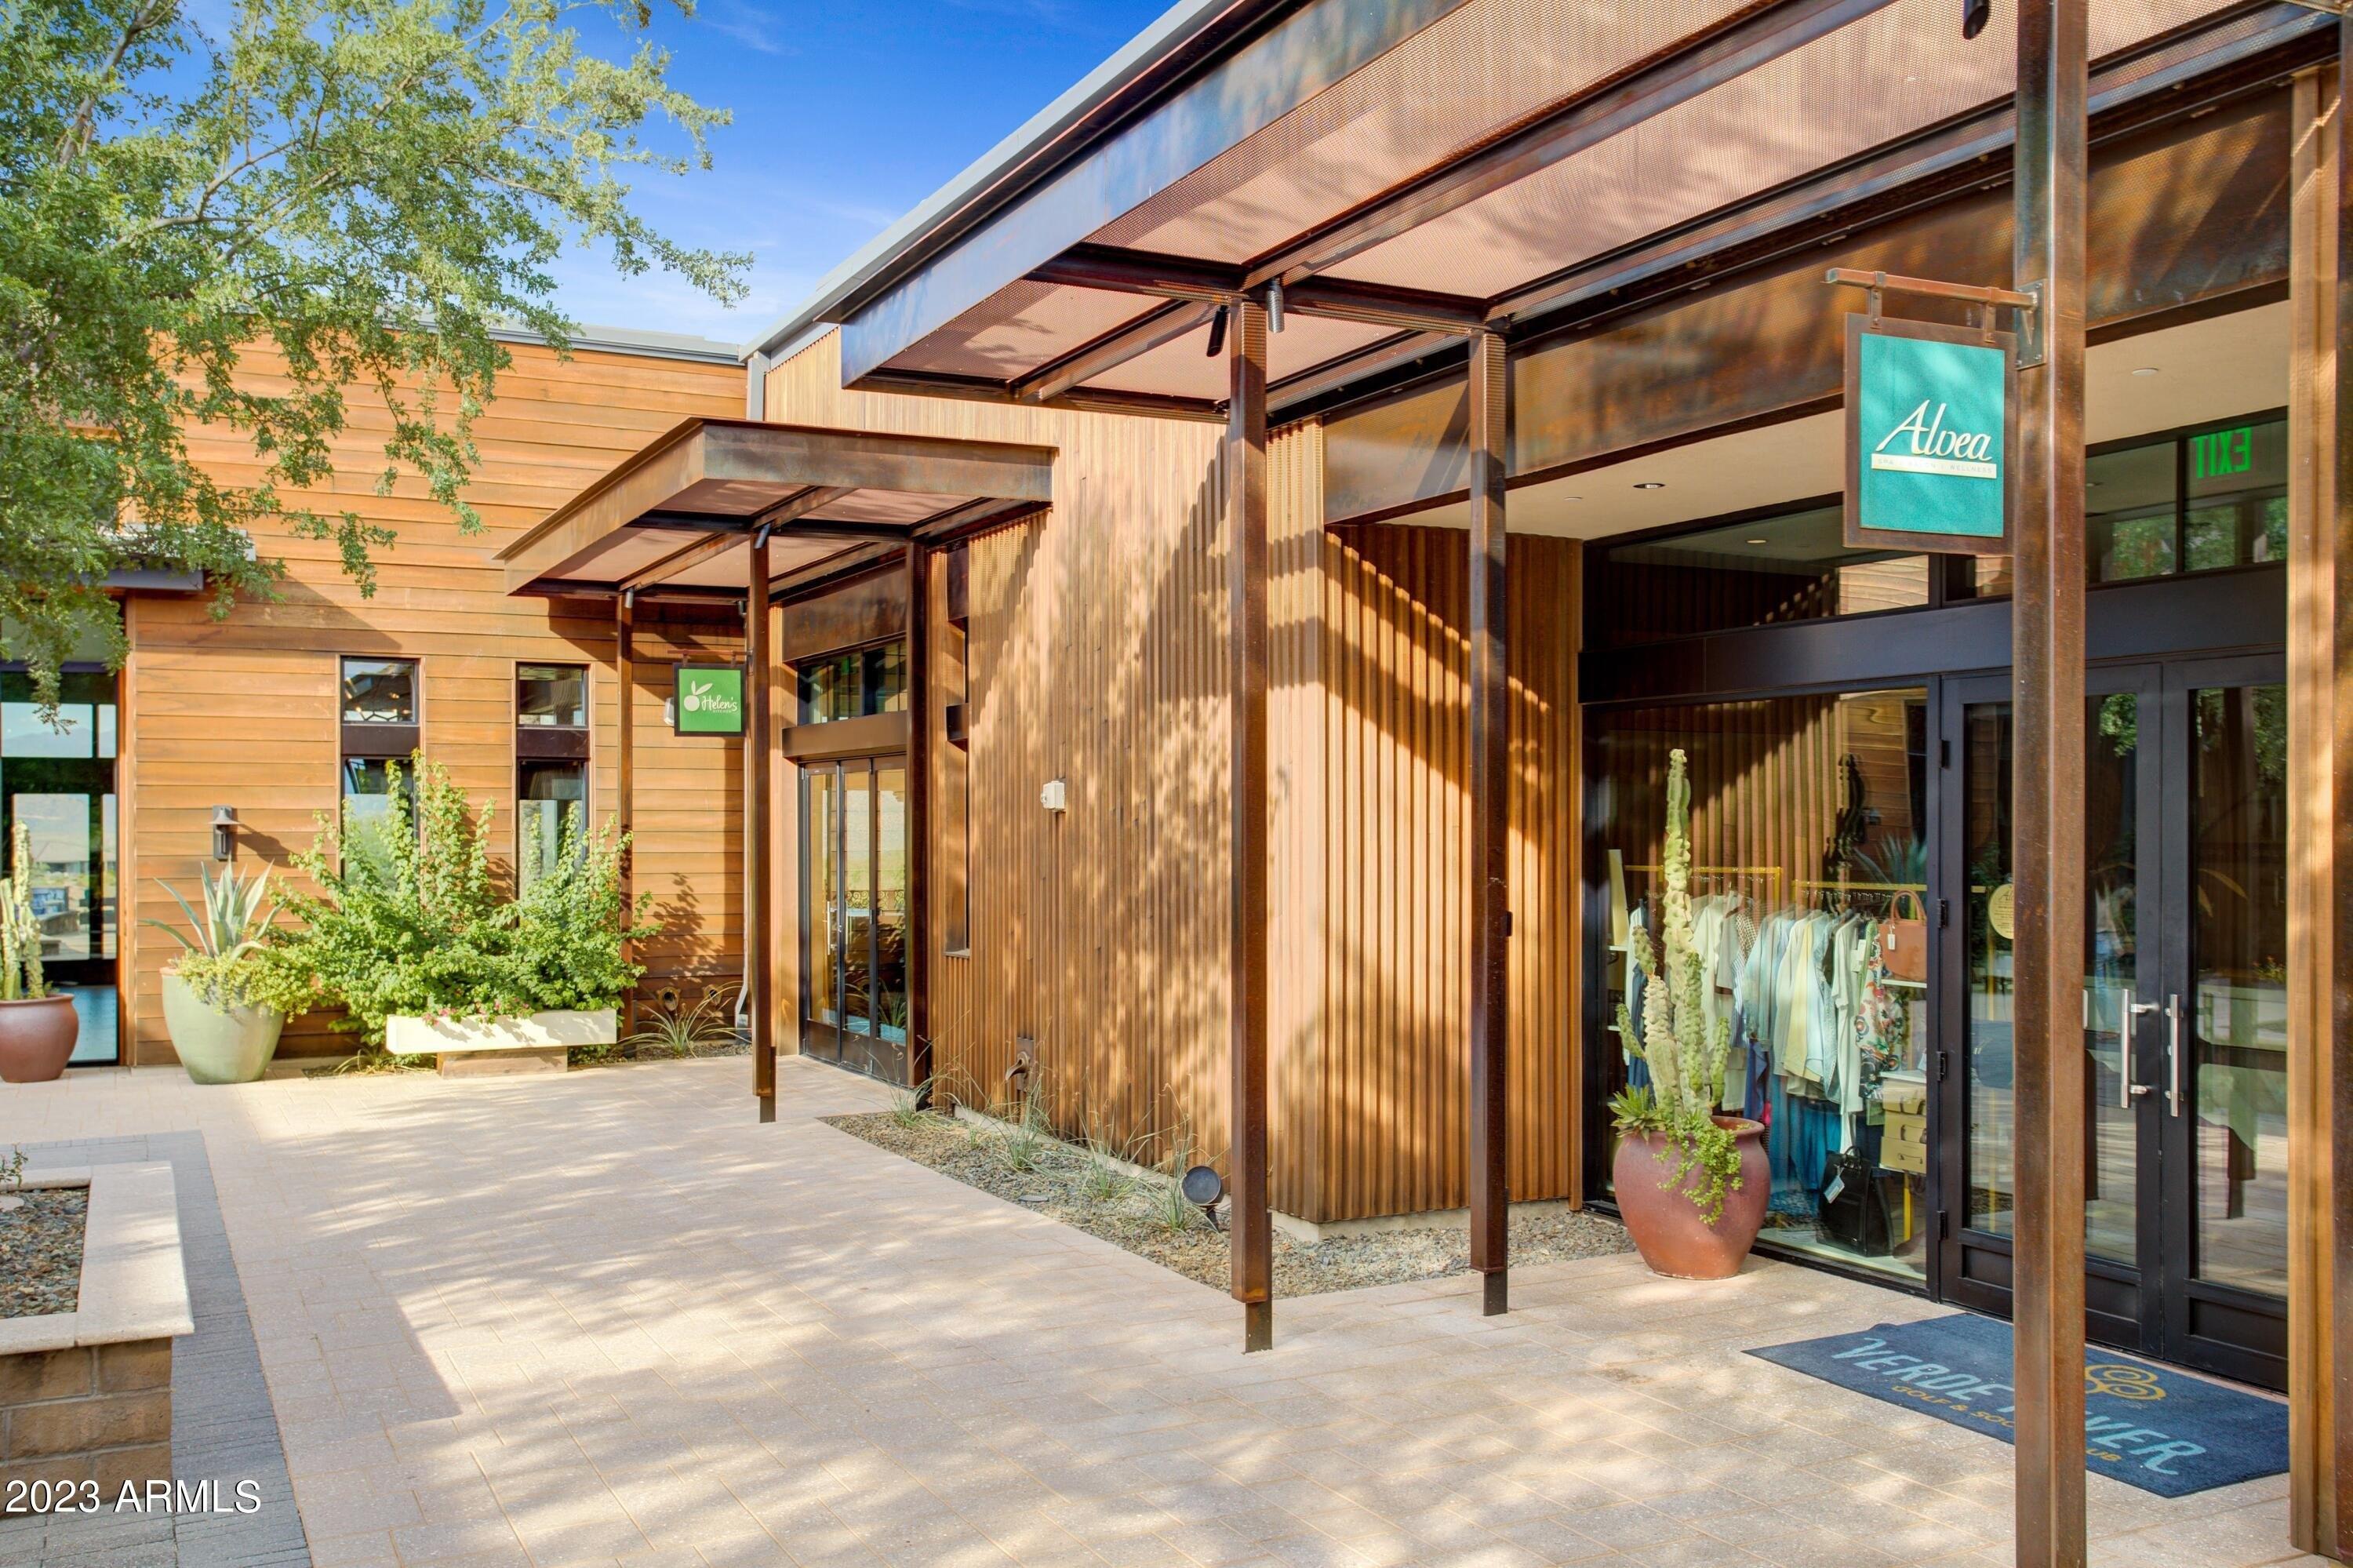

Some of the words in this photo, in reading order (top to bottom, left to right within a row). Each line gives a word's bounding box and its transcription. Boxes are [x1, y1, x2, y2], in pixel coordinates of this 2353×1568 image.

[1875, 399, 1992, 460] Aloea
[1950, 464, 1993, 474] WELLNESS
[701, 694, 737, 711] Helen's
[1831, 1337, 2014, 1401] VERDE
[1891, 1385, 1952, 1404] GOLF
